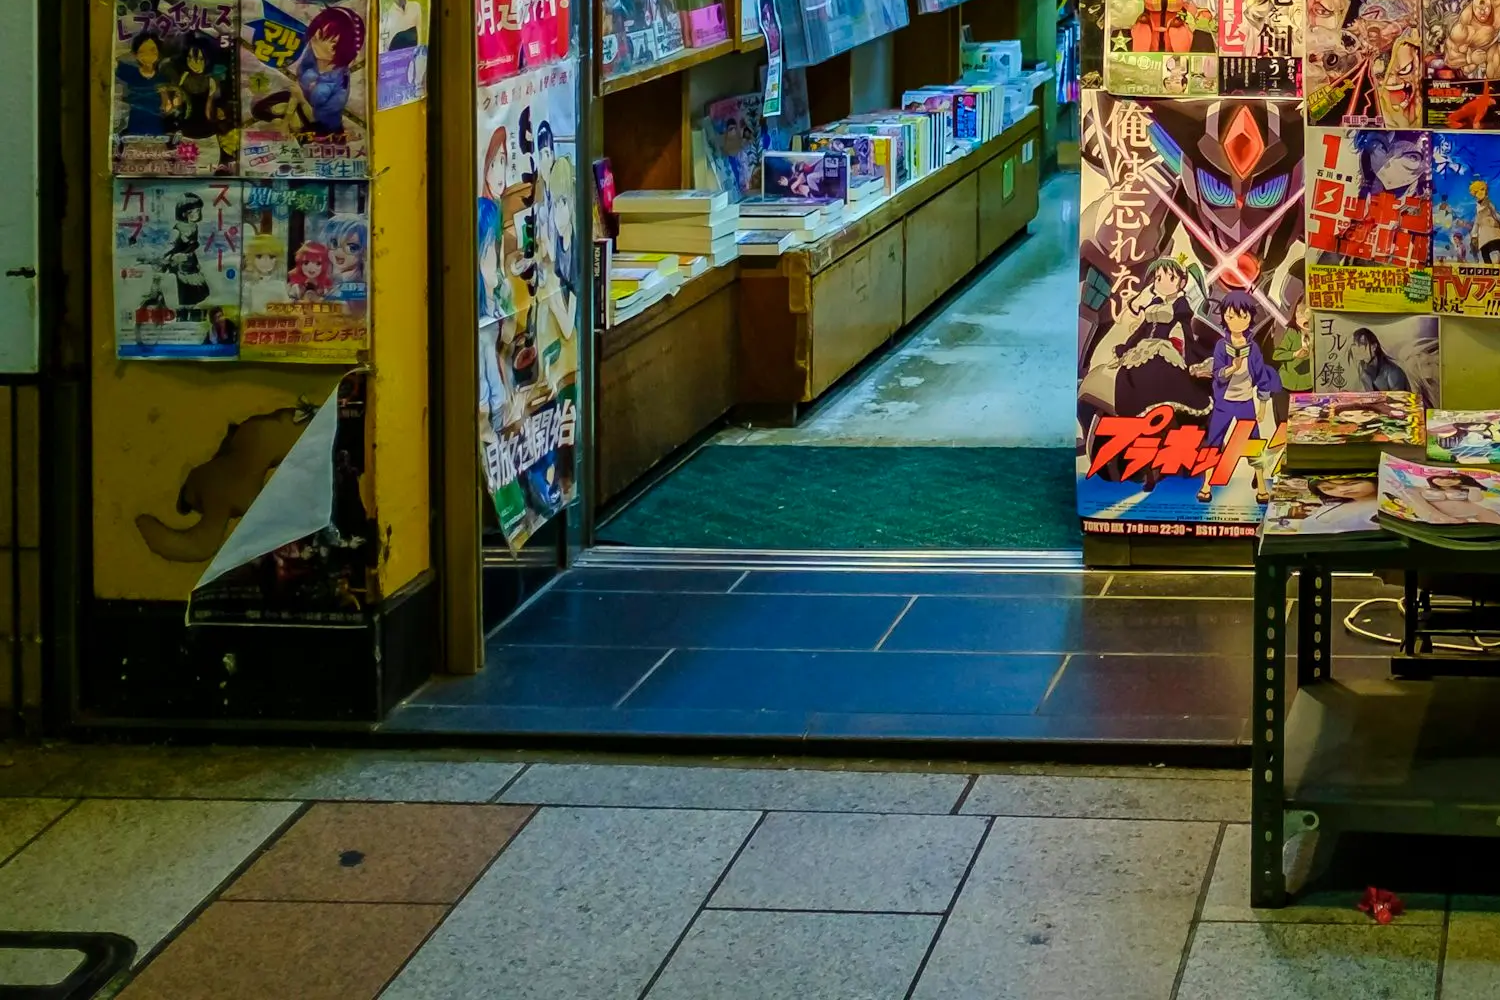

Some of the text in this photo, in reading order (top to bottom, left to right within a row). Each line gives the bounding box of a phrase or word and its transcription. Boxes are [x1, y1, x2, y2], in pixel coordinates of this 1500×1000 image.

[120, 184, 149, 244] カブ
[204, 184, 238, 272] スーパー
[1104, 100, 1156, 323] 俺は忘れない
[1086, 405, 1287, 486] プラネット
[1083, 521, 1109, 533] TOKYO
